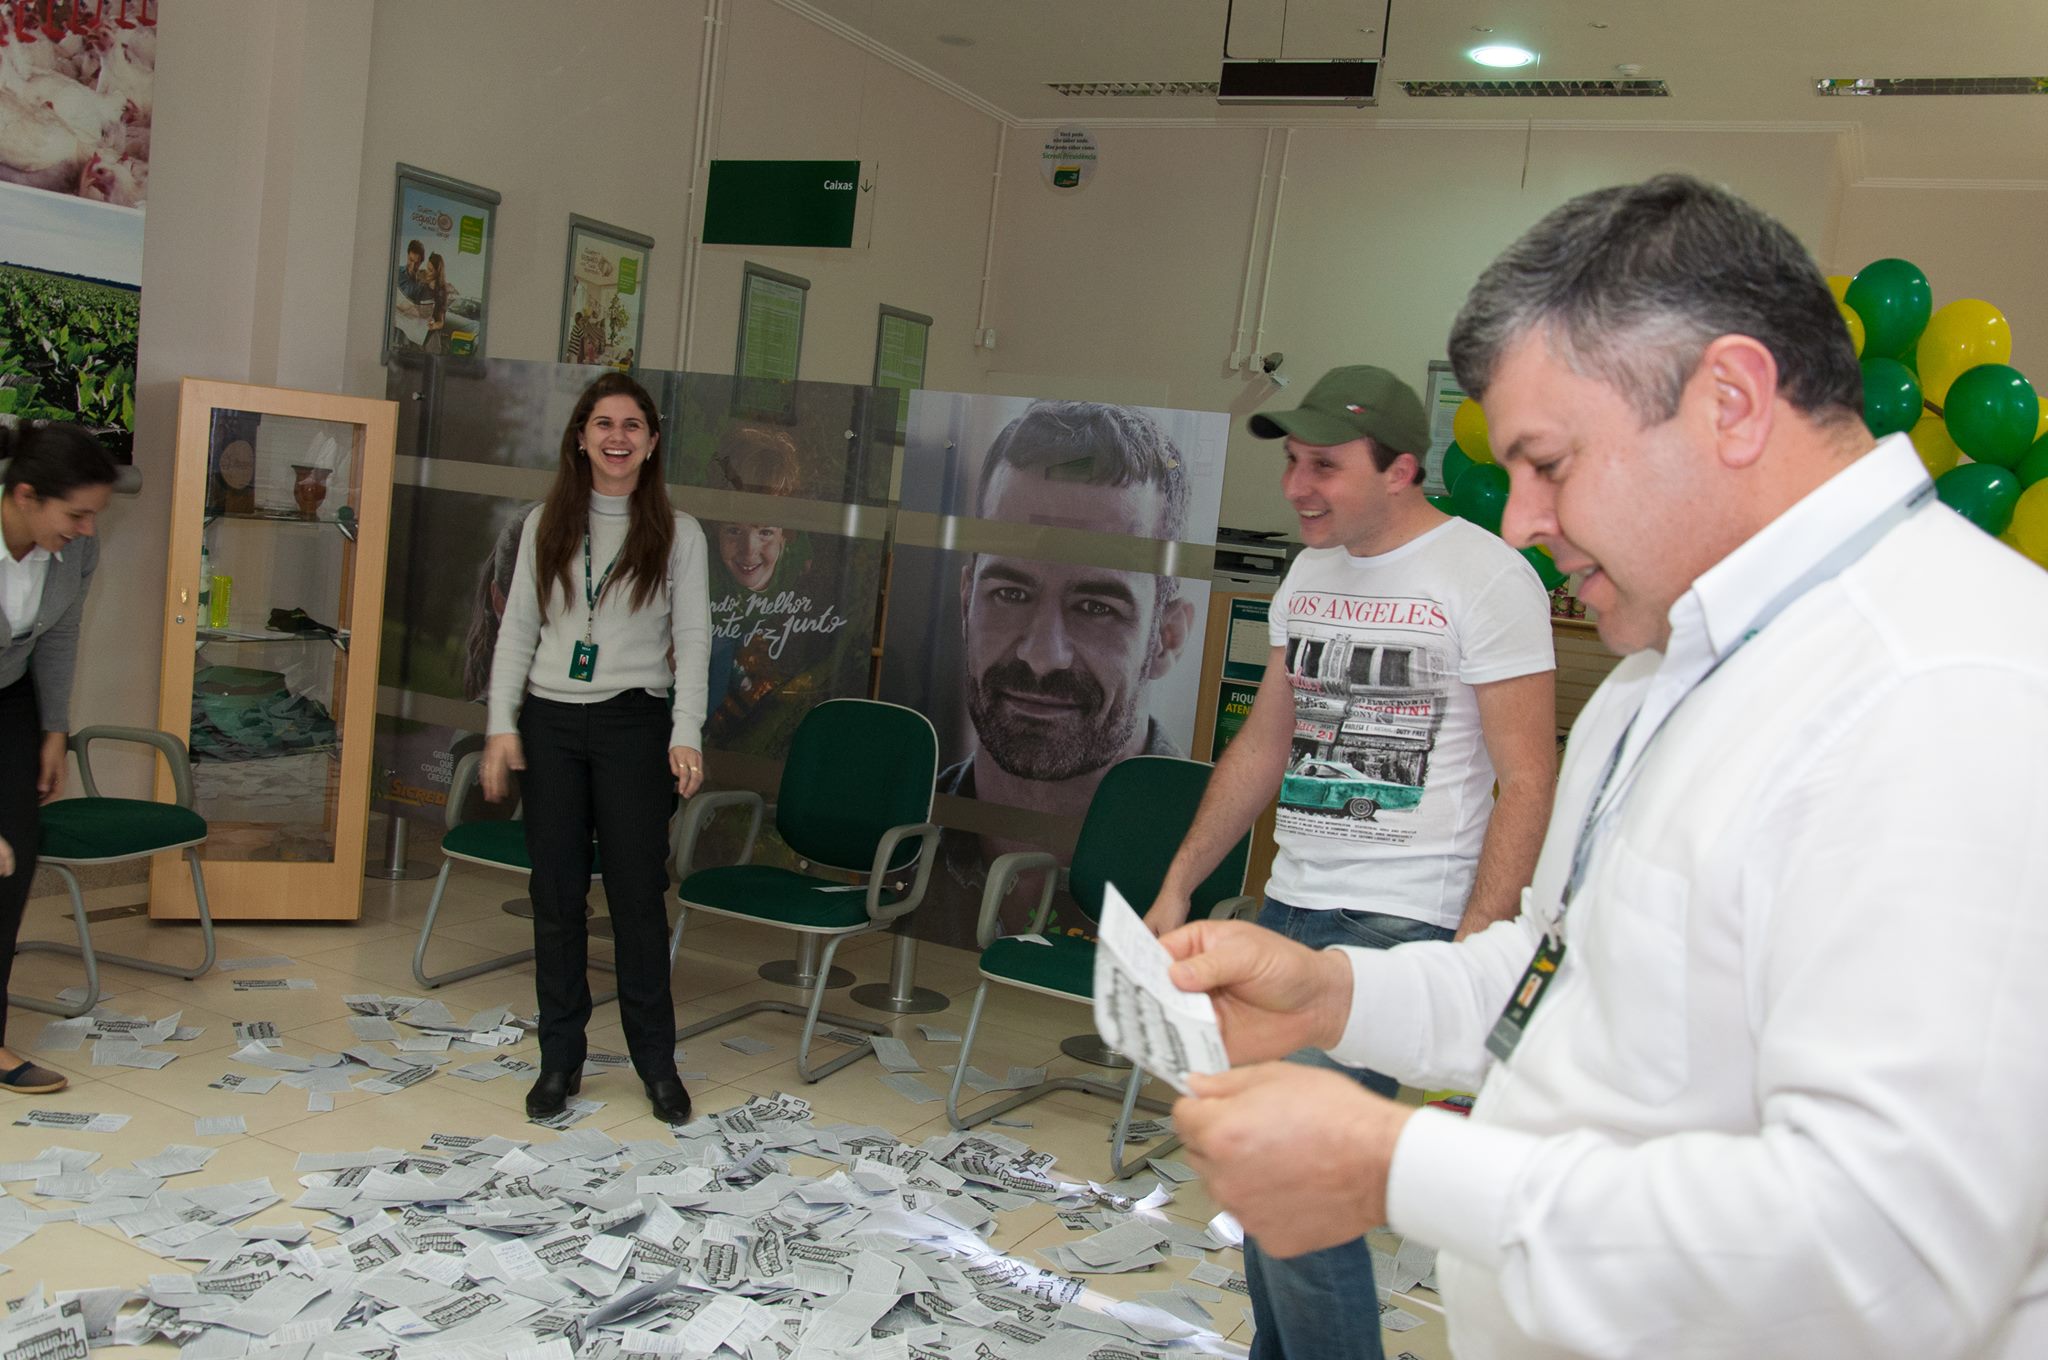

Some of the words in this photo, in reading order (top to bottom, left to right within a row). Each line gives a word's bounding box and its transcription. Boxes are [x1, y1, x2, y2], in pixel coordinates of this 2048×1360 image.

[823, 179, 854, 191] Caixas
[1322, 597, 1449, 629] ANGELES
[1231, 692, 1257, 705] FIQU
[1225, 703, 1251, 716] ATEN
[433, 750, 454, 762] GENTE
[439, 759, 454, 770] QUE
[787, 1242, 850, 1258] Poupança
[789, 1248, 836, 1264] Premia
